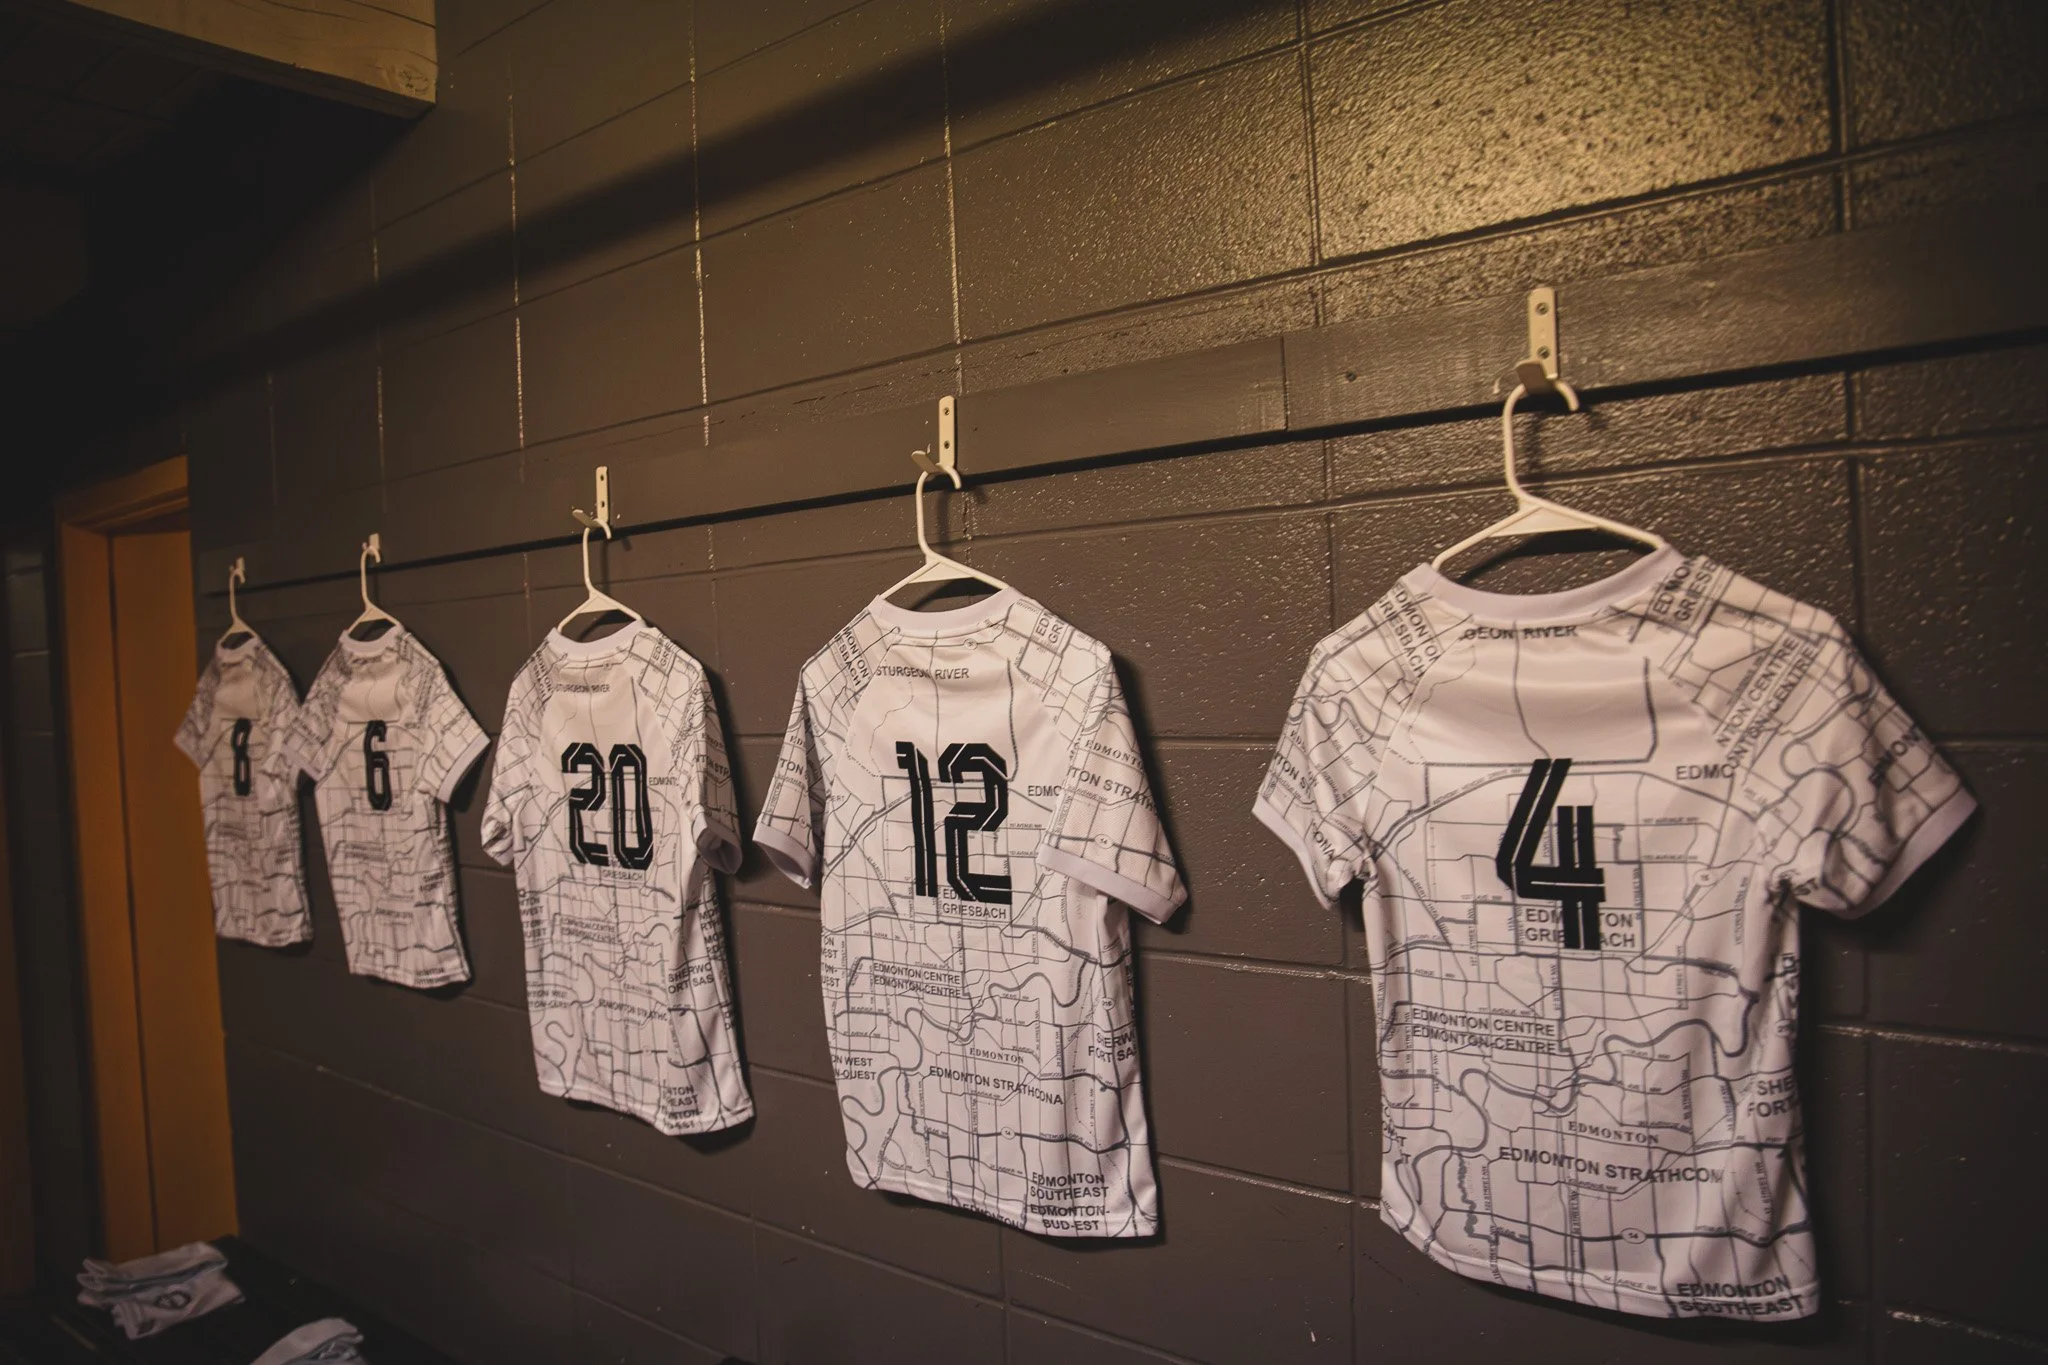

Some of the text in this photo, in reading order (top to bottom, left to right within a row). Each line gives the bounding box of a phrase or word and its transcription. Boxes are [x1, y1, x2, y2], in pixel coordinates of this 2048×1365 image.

[1523, 625, 1579, 639] RIVER
[876, 666, 970, 680] STURGEON RIVER
[231, 717, 252, 797] 8
[364, 719, 392, 812] 6
[561, 742, 654, 870] 20
[896, 741, 1012, 905] 12
[1496, 758, 1606, 951] 4
[942, 902, 1007, 919] GRIESBACH
[873, 962, 961, 985] EDMONTON CENTRE
[1412, 1007, 1556, 1037] EDMONTON CENTRE
[844, 1055, 873, 1067] WEST
[970, 1047, 1024, 1063] EDMONTON
[929, 1065, 1065, 1105] EDMONTON STRATHCONA
[1567, 1121, 1660, 1144] EDMONTON
[1499, 1146, 1601, 1175] EDMONTON
[1031, 1171, 1105, 1187] EDMONTON
[1030, 1186, 1109, 1200] SOUTHEAST
[1676, 1274, 1791, 1298] EDMONTON
